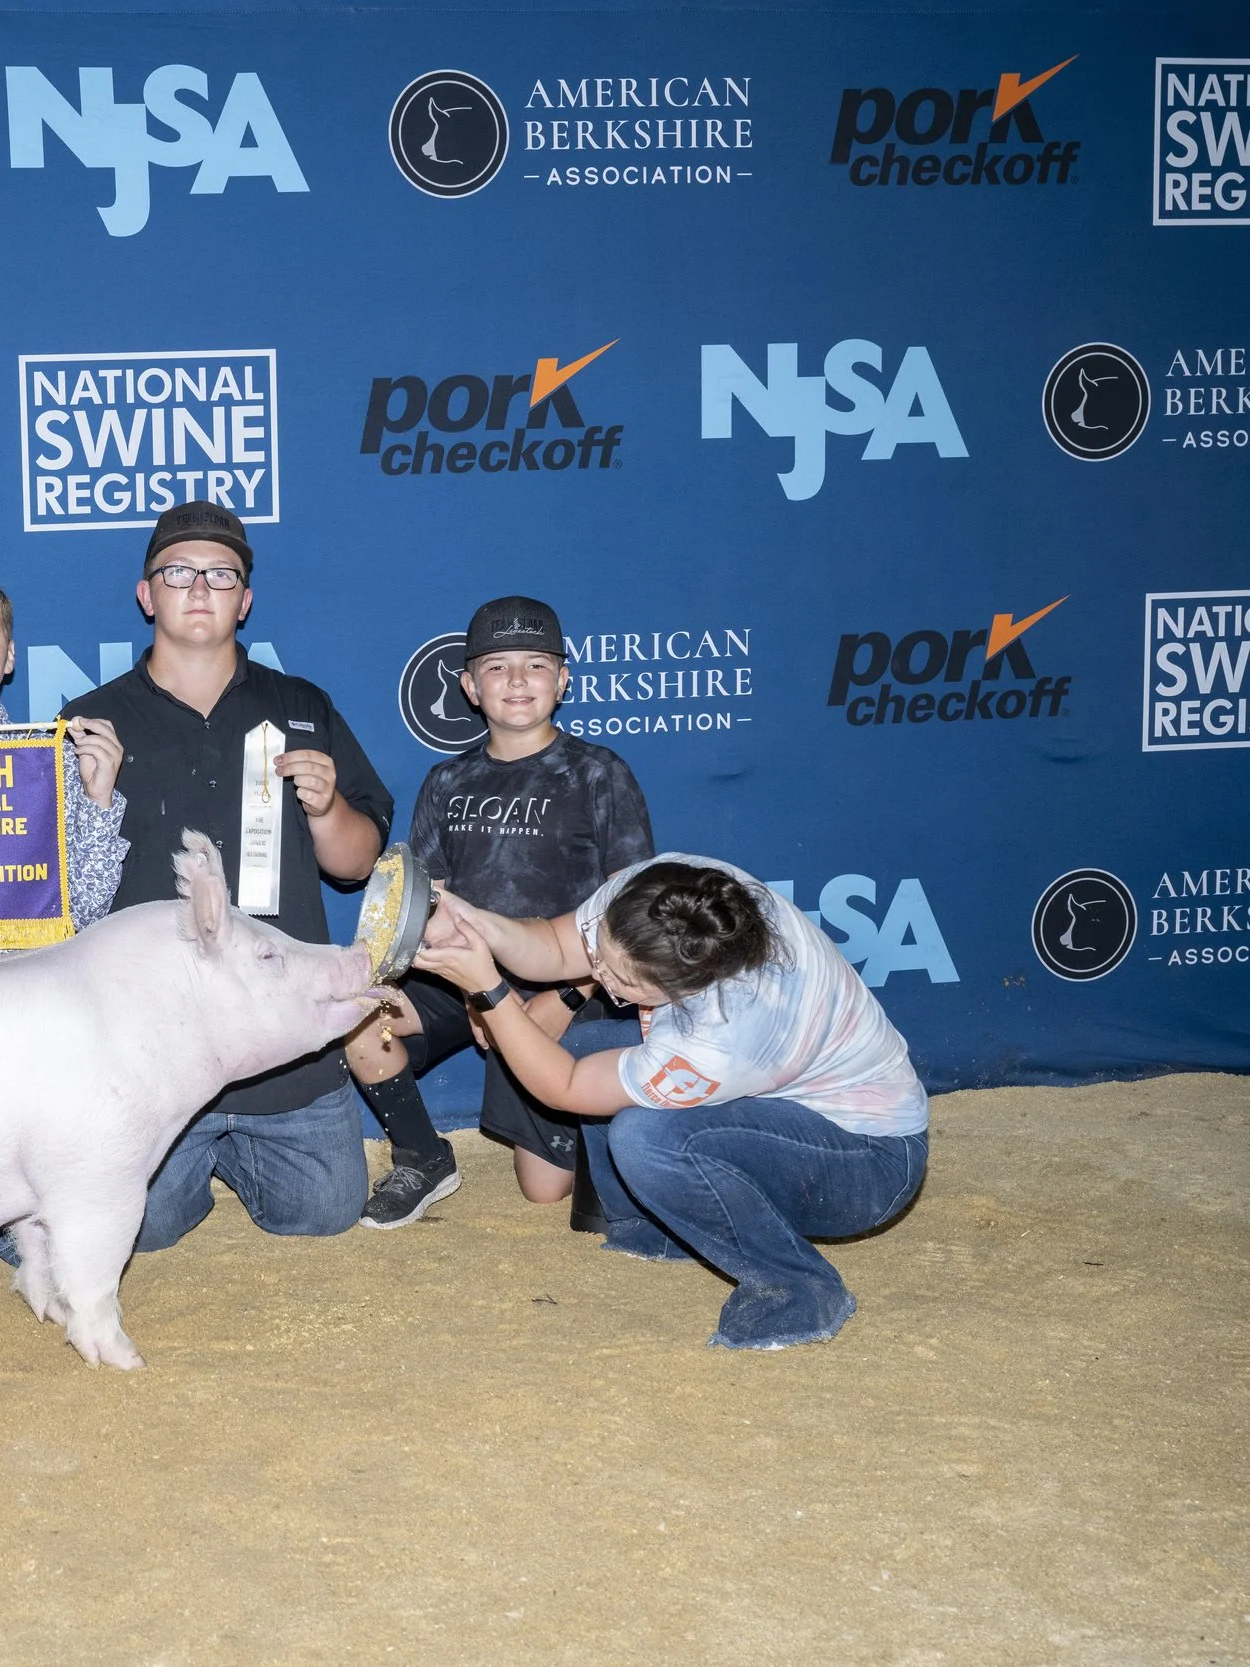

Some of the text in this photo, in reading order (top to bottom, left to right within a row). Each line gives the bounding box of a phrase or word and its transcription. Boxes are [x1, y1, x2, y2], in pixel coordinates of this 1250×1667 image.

[524, 76, 752, 109] AMERICAN
[829, 54, 1080, 167] pork
[5, 63, 311, 237] NJSA
[524, 117, 753, 151] BERKSHIRE
[547, 165, 732, 186] ASSOCIATION
[849, 140, 1081, 188] checkoff
[33, 365, 262, 405] NATIONAL
[359, 338, 621, 455] pork
[34, 405, 266, 470] SWINE
[701, 339, 970, 501] NJSA
[380, 424, 623, 477] checkoff
[35, 468, 266, 516] REGISTRY
[563, 628, 752, 665] MERICAN
[828, 595, 1071, 707] pork
[558, 667, 753, 704] ERKSHIRE
[846, 677, 1072, 727] checkoff
[1154, 698, 1250, 737] REGI
[447, 795, 551, 823] SLOAN
[481, 825, 492, 834] IT
[1150, 905, 1250, 936] BERK
